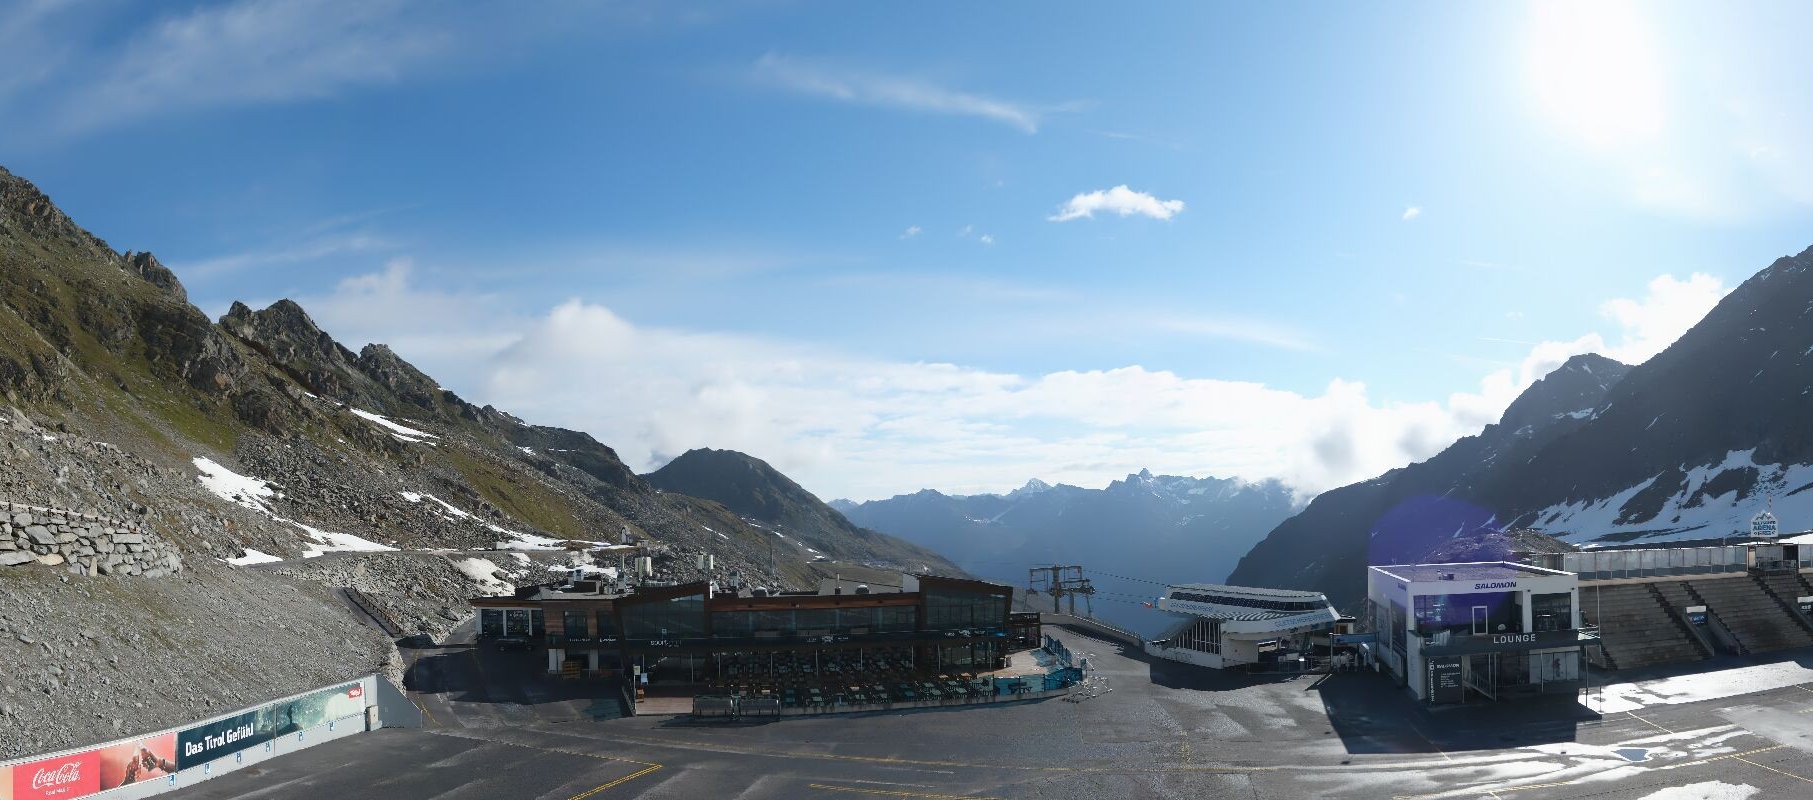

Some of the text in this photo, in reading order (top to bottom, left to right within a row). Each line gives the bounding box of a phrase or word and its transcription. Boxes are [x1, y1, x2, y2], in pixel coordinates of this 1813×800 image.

[1474, 581, 1517, 590] SALOMON
[1493, 634, 1536, 644] LOUNGE
[185, 722, 254, 757] Das Tirol Gefühl
